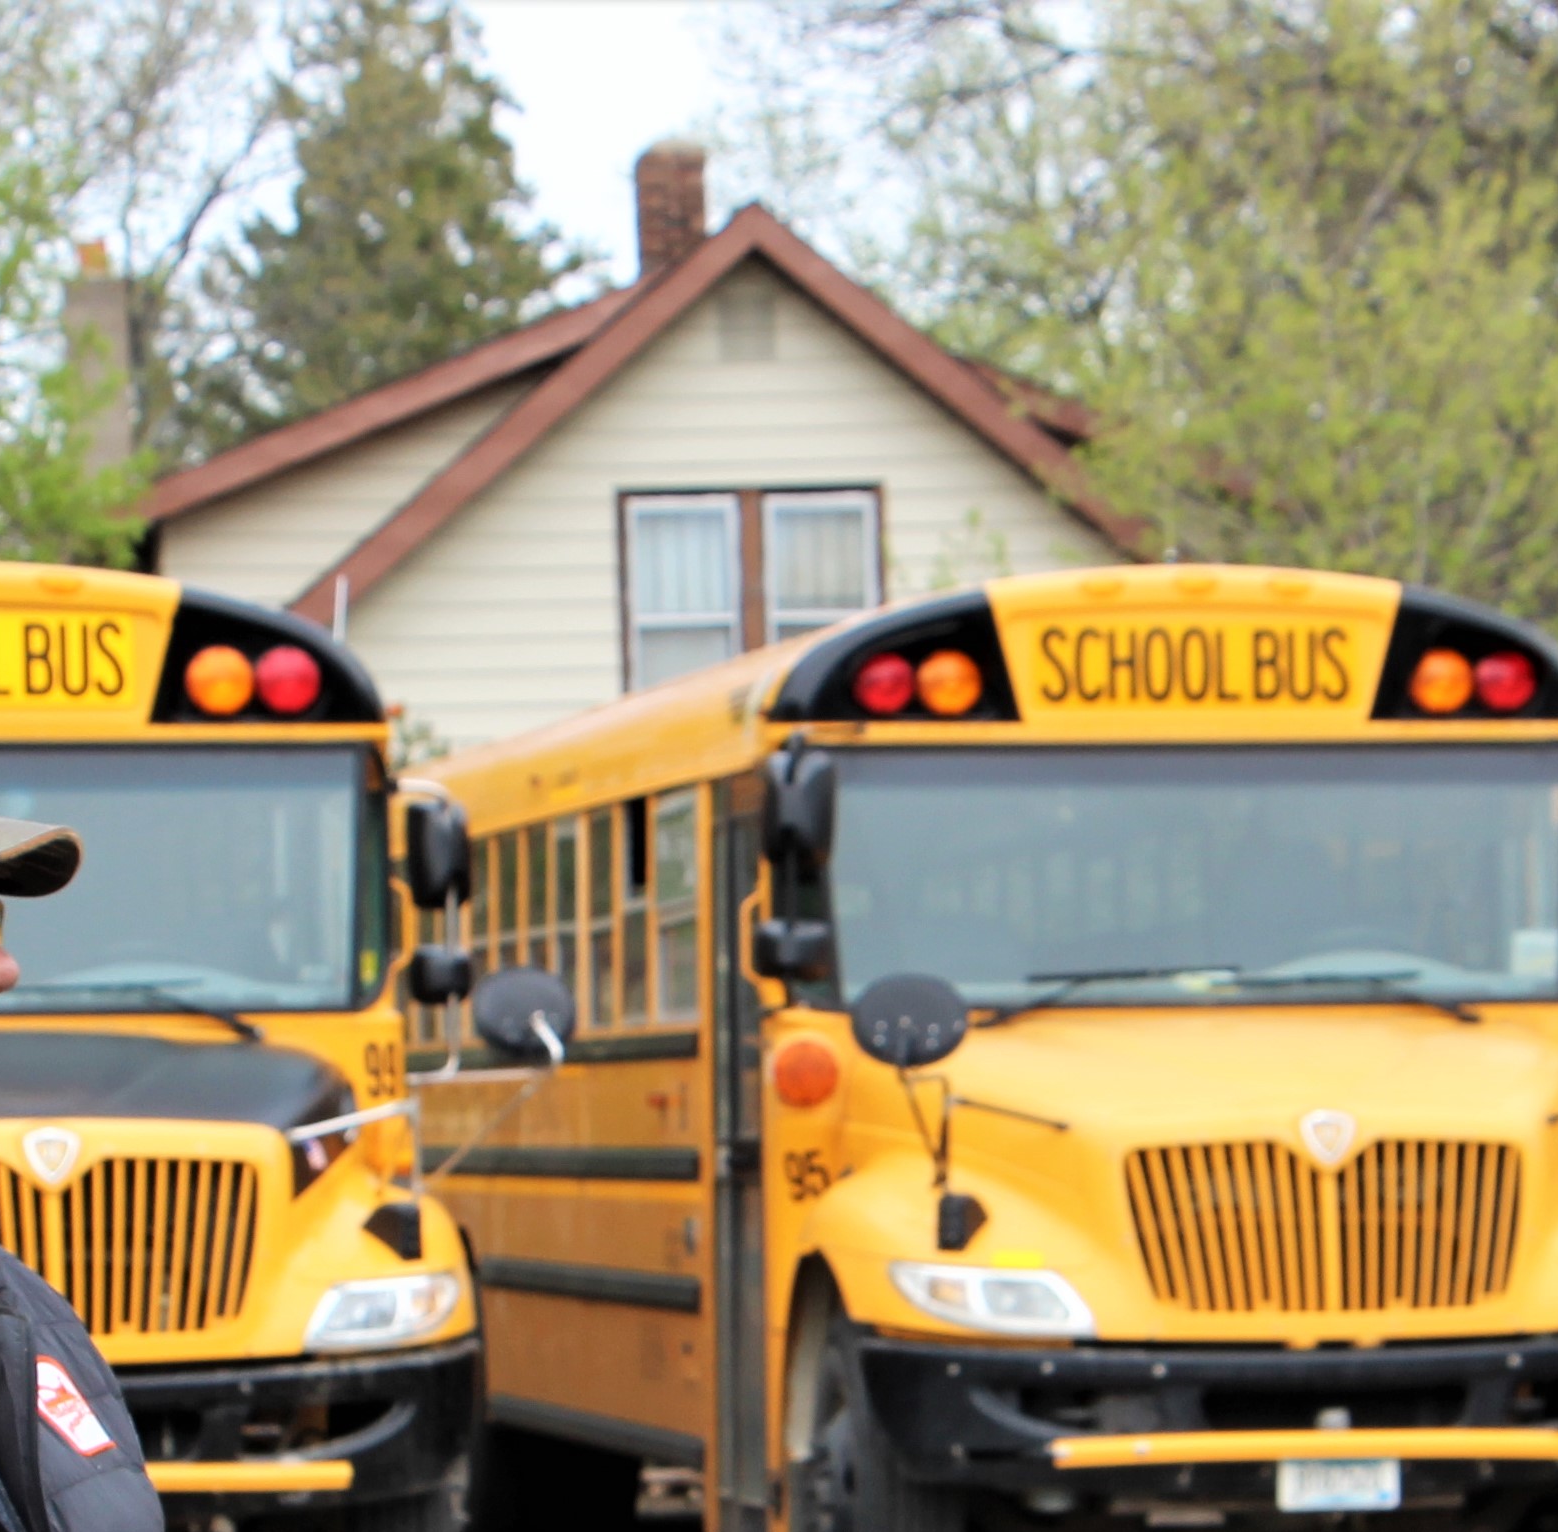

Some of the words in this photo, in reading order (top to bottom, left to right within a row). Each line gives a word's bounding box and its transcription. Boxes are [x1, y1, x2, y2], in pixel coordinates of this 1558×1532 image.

[24, 621, 125, 697] BUS
[1039, 627, 1240, 702] SCHOOL
[1252, 627, 1350, 702] BUS
[784, 1148, 832, 1203] 95
